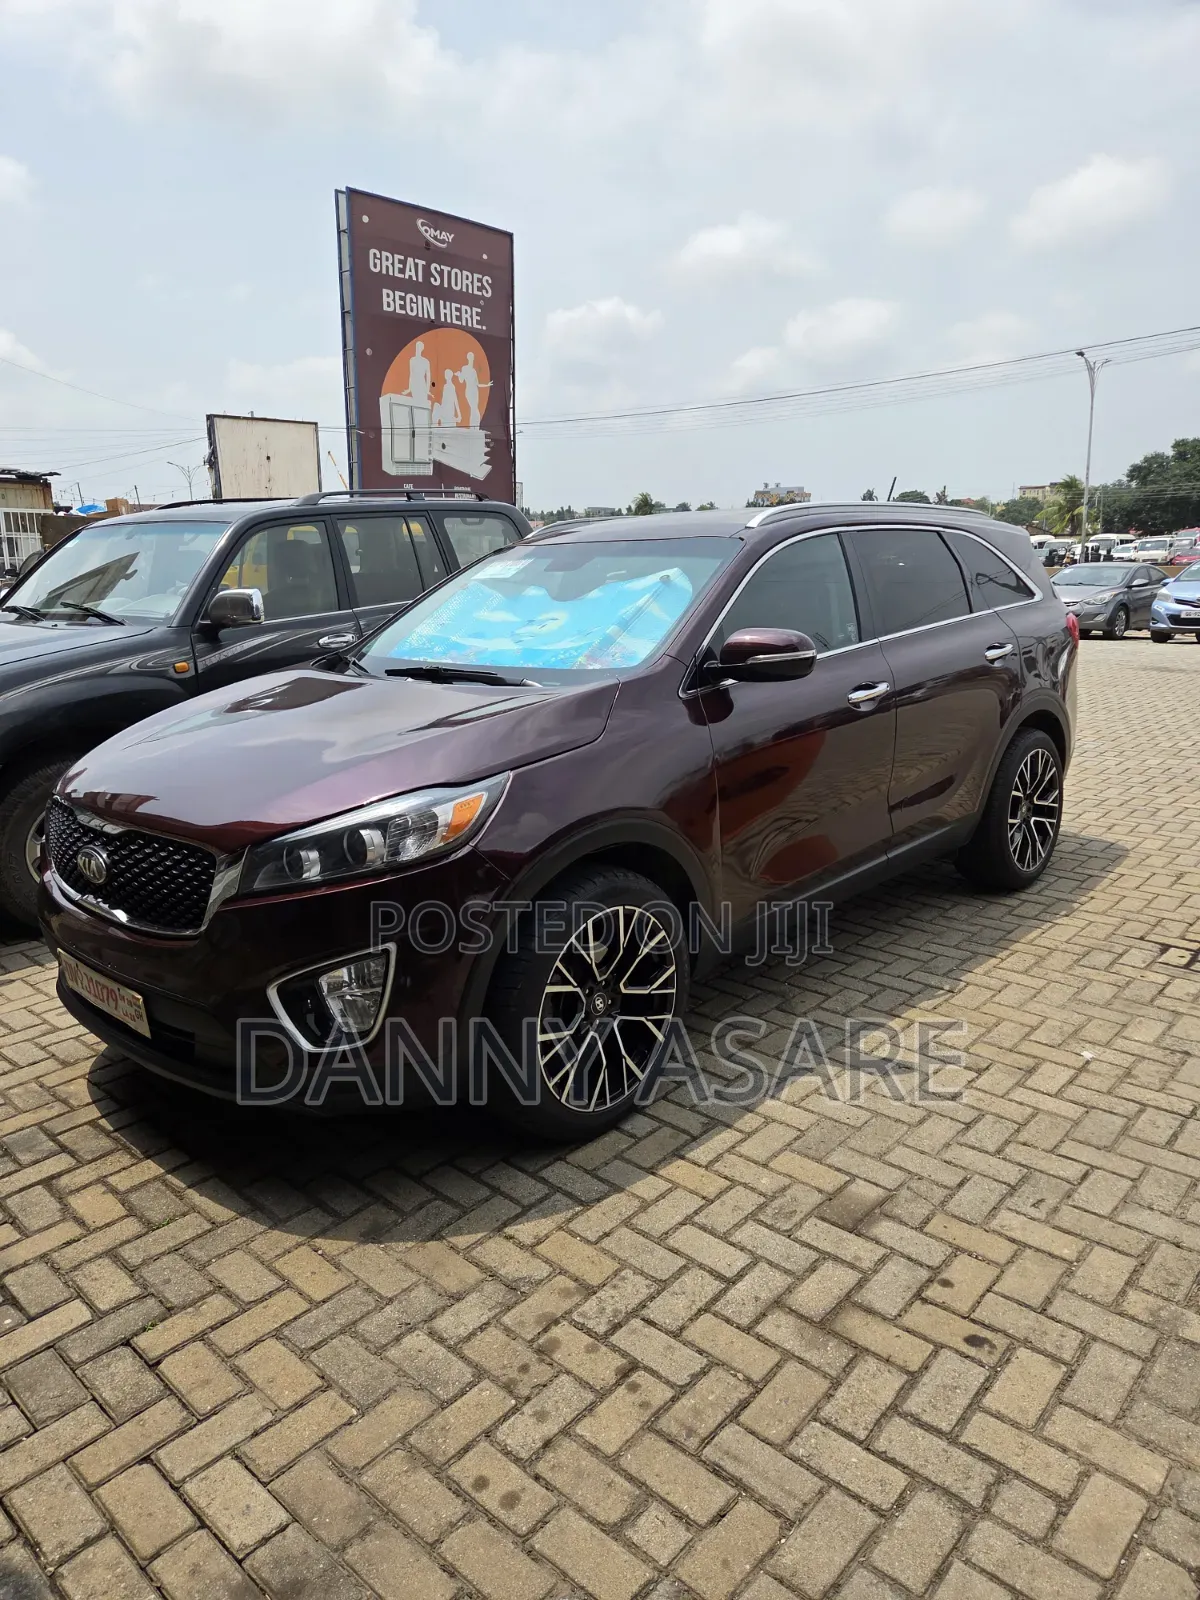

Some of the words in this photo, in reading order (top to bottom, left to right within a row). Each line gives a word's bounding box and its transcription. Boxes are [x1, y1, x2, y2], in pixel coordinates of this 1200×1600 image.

[369, 249, 426, 282] GREAT
[430, 263, 492, 298] STORES
[382, 288, 435, 320] BEGIN
[439, 300, 487, 330] HERE.
